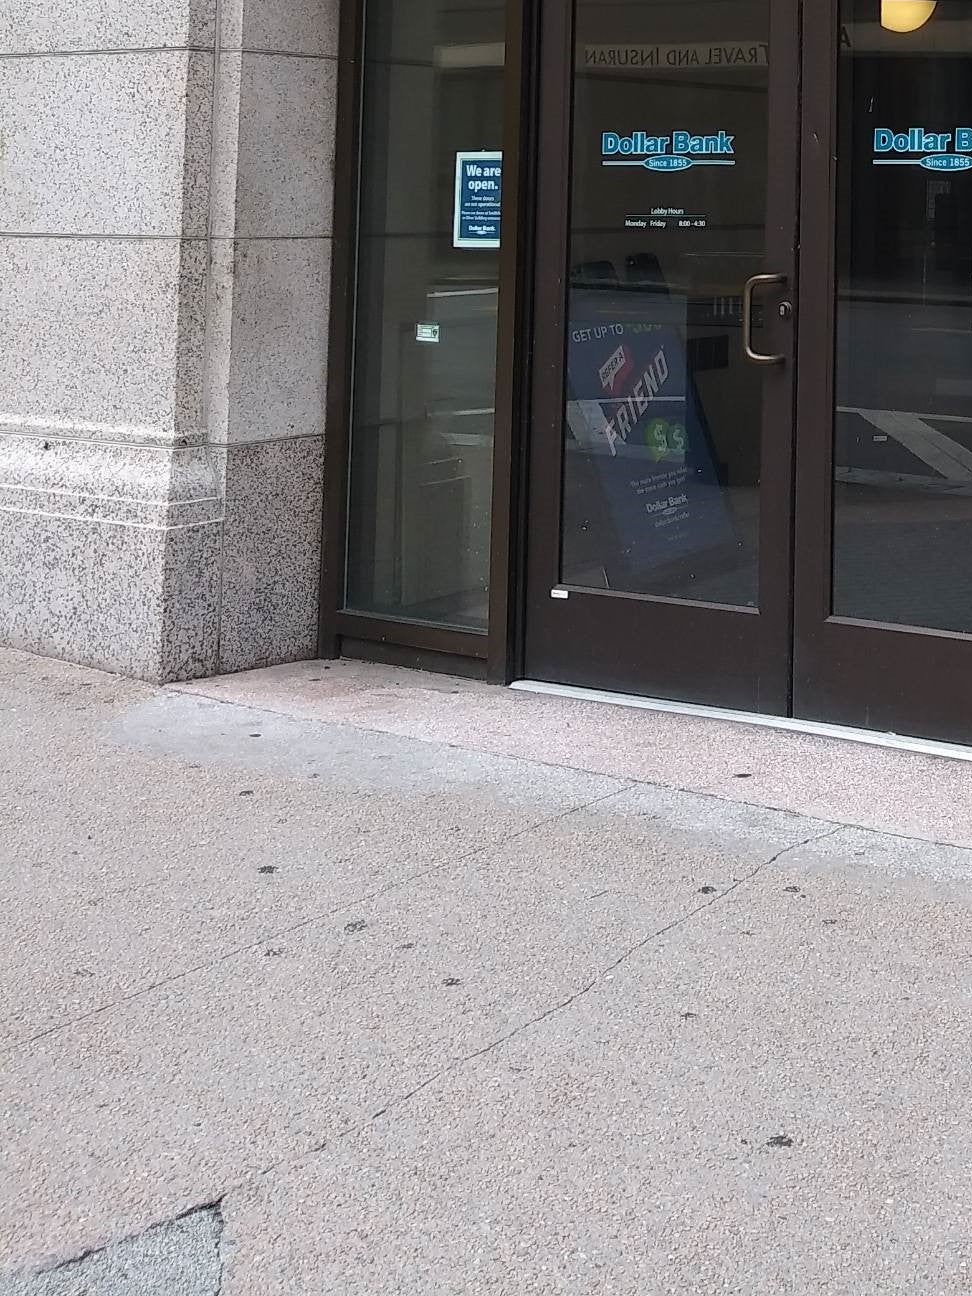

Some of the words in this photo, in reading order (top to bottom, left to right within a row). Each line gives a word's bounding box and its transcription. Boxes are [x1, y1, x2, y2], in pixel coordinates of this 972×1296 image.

[602, 131, 670, 155] Dollar
[672, 130, 735, 154] Bank
[873, 127, 951, 153] Dollar
[648, 159, 667, 167] Since
[669, 159, 687, 167] 1855
[926, 158, 947, 167] Since
[949, 158, 970, 167] 1855
[466, 165, 482, 177] We
[483, 167, 502, 177] are
[468, 180, 499, 193] open.
[650, 207, 667, 216] Lobby
[624, 220, 647, 228] Monday
[649, 220, 667, 228] Friday
[572, 328, 592, 343] GET
[593, 326, 607, 340] UP
[608, 323, 624, 336] TO
